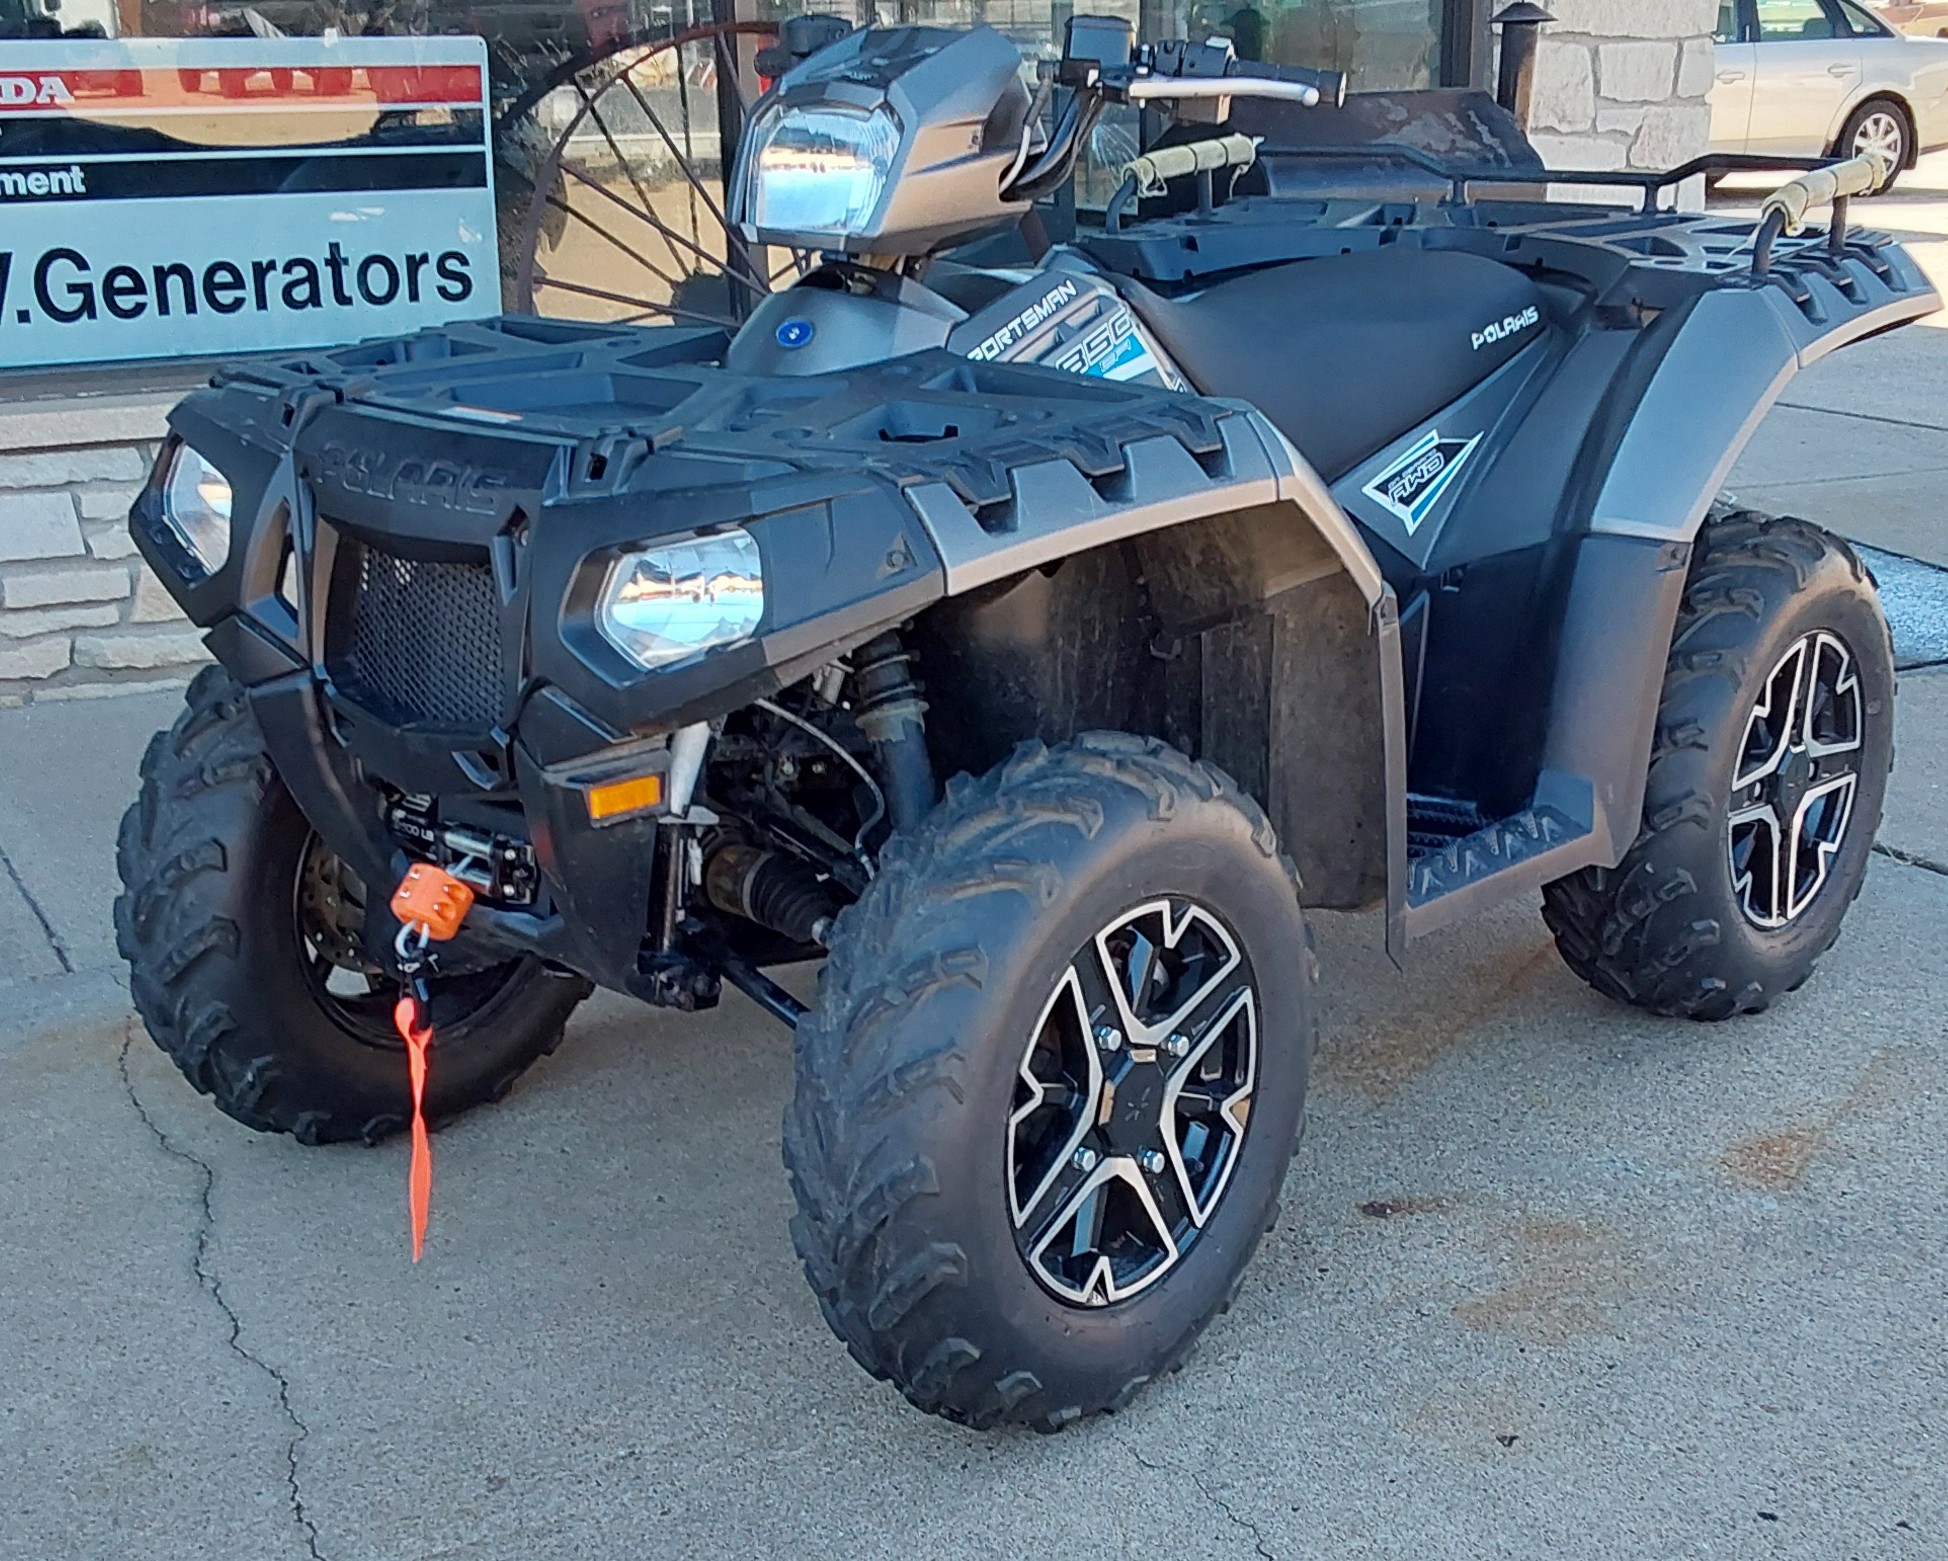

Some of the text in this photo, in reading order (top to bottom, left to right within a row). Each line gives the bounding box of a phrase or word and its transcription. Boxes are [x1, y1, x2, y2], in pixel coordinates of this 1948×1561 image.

[0, 165, 87, 196] ment
[966, 279, 1077, 362] PORTSMAN
[1470, 305, 1540, 351] POLARIS
[1387, 451, 1445, 508] AWD
